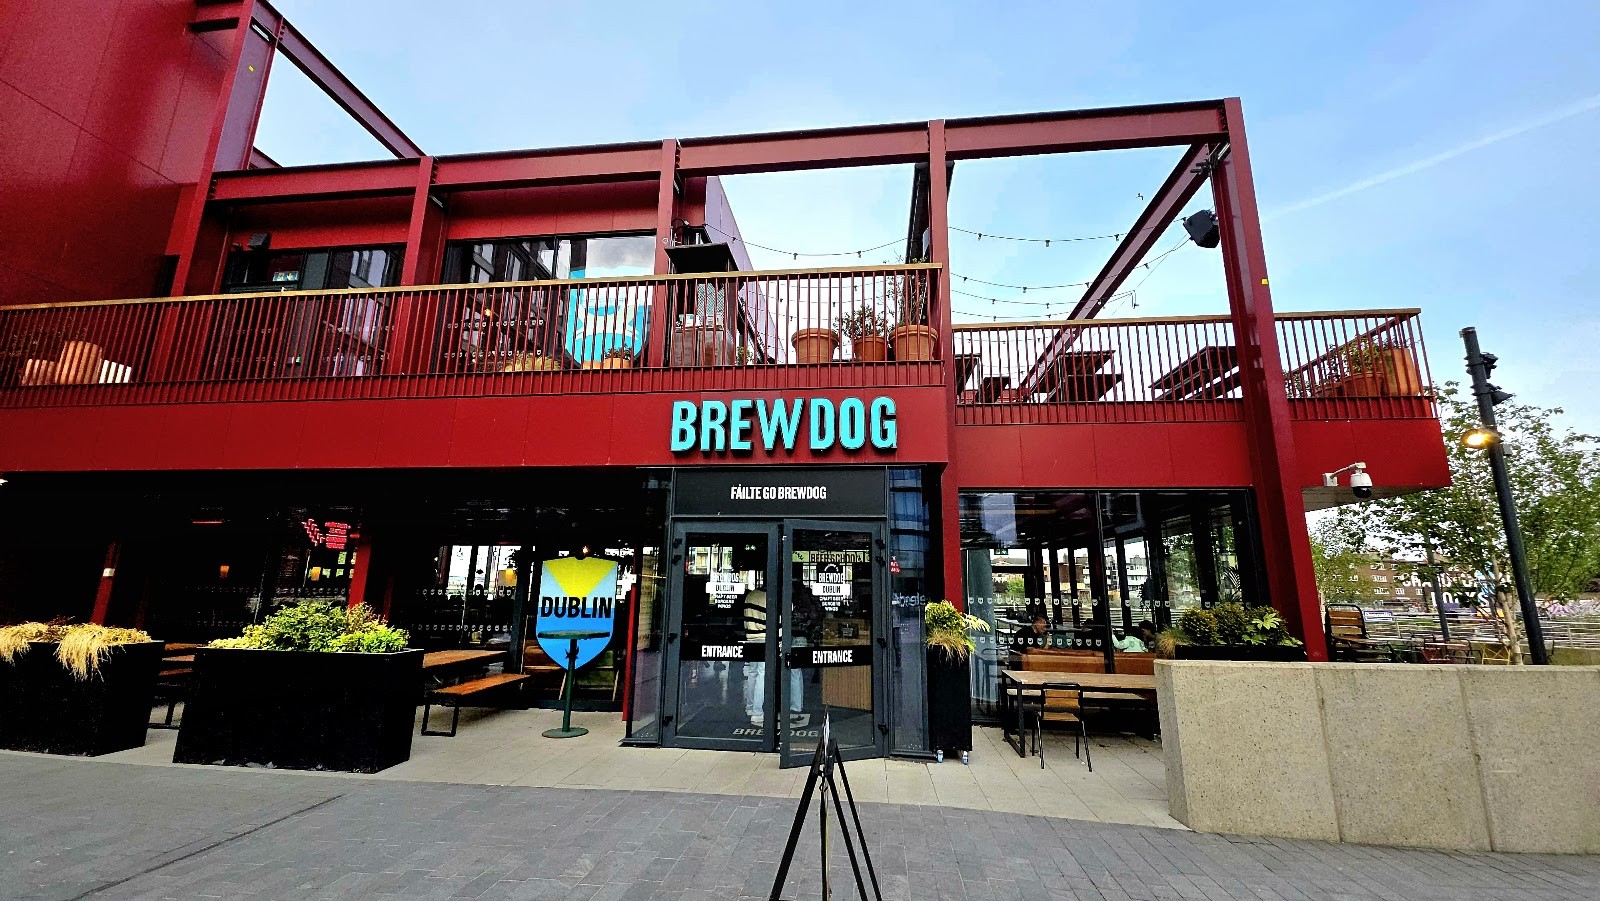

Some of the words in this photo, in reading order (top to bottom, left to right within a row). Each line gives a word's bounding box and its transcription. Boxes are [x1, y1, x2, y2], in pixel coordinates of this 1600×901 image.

[670, 396, 897, 453] BREWDOG
[730, 484, 762, 500] FÁILTE
[763, 486, 777, 500] GO
[778, 486, 827, 500] BREWDOG
[822, 585, 841, 594] DUBLIN
[540, 596, 613, 619] DUBLIN
[701, 645, 744, 658] ENTRANCE
[812, 649, 853, 664] ENTRANCE
